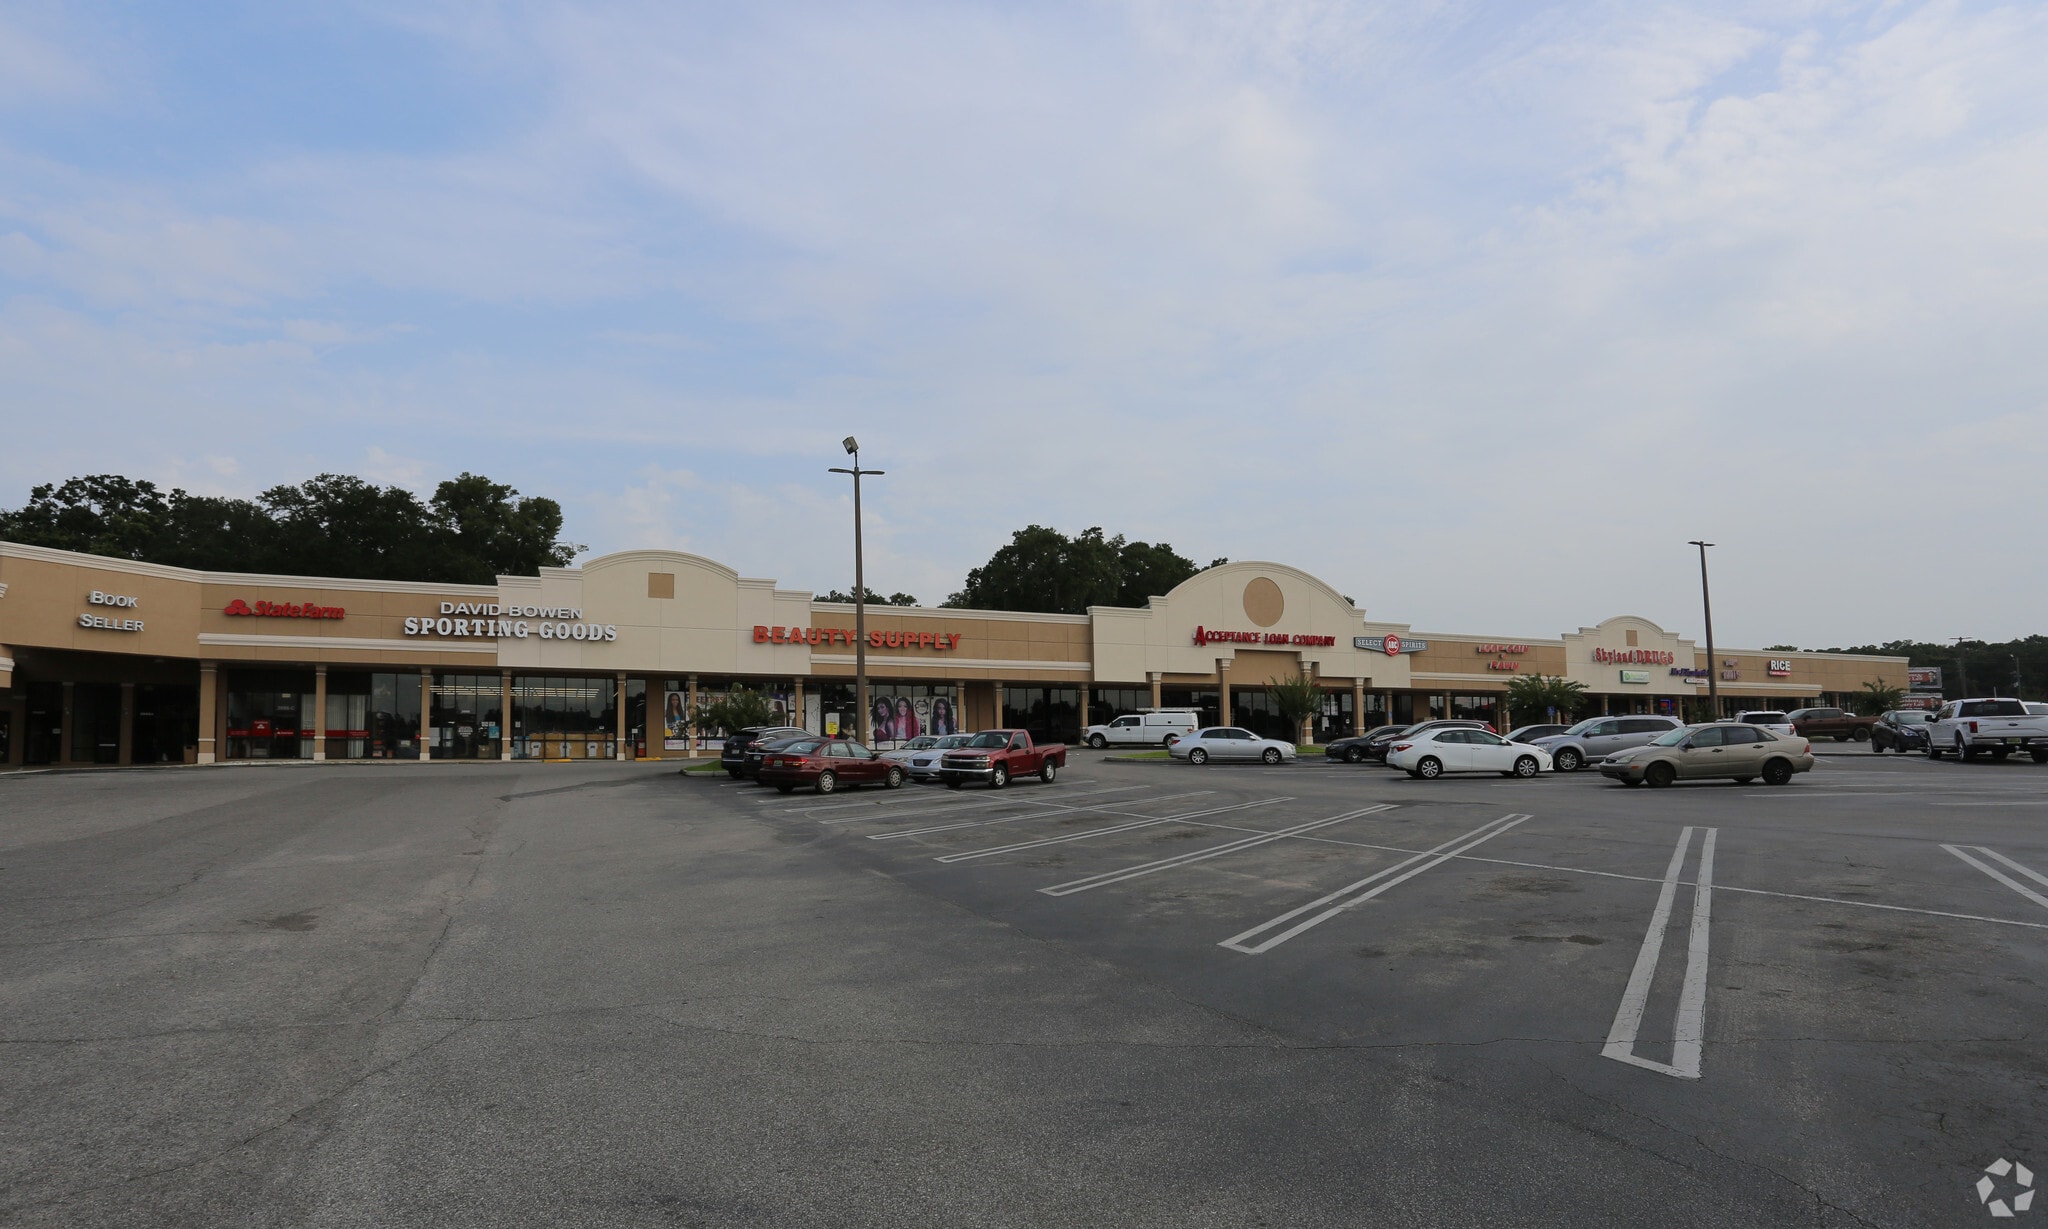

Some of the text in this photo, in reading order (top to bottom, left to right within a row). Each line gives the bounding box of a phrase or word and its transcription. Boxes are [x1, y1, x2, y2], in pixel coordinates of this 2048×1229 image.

[90, 590, 138, 607] BOOK
[440, 602, 583, 619] DAVID BOWEN
[80, 613, 144, 631] SELLER
[404, 617, 617, 641] SPORTING GOODS
[753, 626, 961, 649] BEAUTY SUPPLY
[1193, 625, 1336, 647] ACCEPTANCE LOAN COMPANY
[1401, 641, 1426, 649] SPIRITS
[1595, 647, 1674, 665] Skyland DRUGS
[1490, 660, 1519, 670] PAWN
[1770, 660, 1791, 671] RICE
